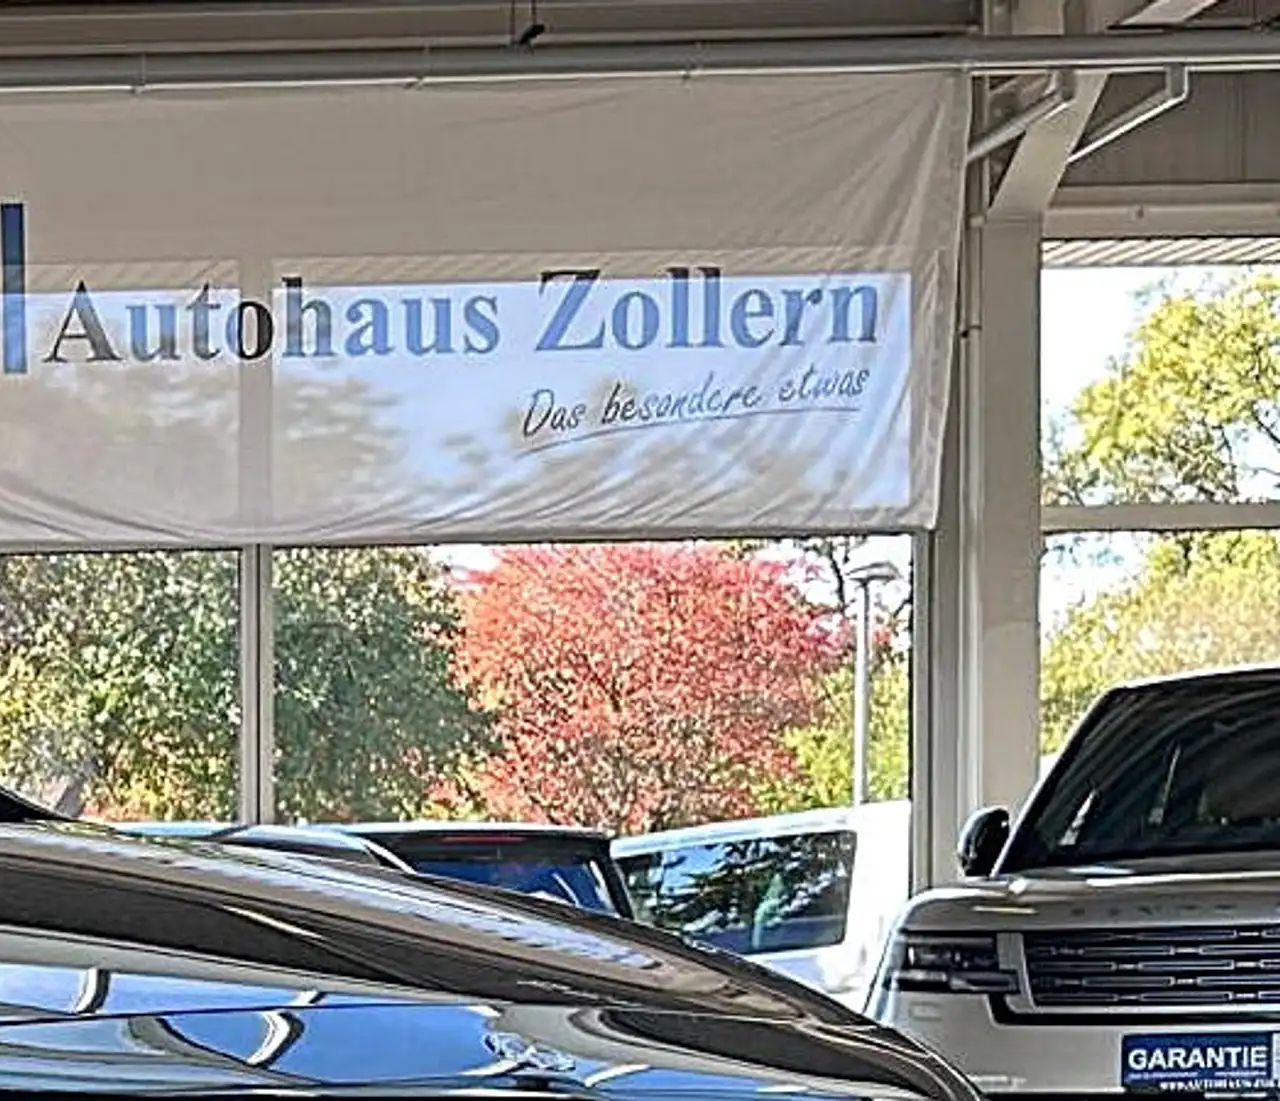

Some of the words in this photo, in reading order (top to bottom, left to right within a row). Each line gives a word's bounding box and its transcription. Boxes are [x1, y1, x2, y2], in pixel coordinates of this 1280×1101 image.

[41, 276, 501, 363] Autohaus
[533, 266, 880, 351] Zollern
[522, 388, 587, 438] Das
[600, 370, 762, 425] besondere
[777, 363, 870, 402] etwas
[1127, 1045, 1269, 1071] GARANTIE
